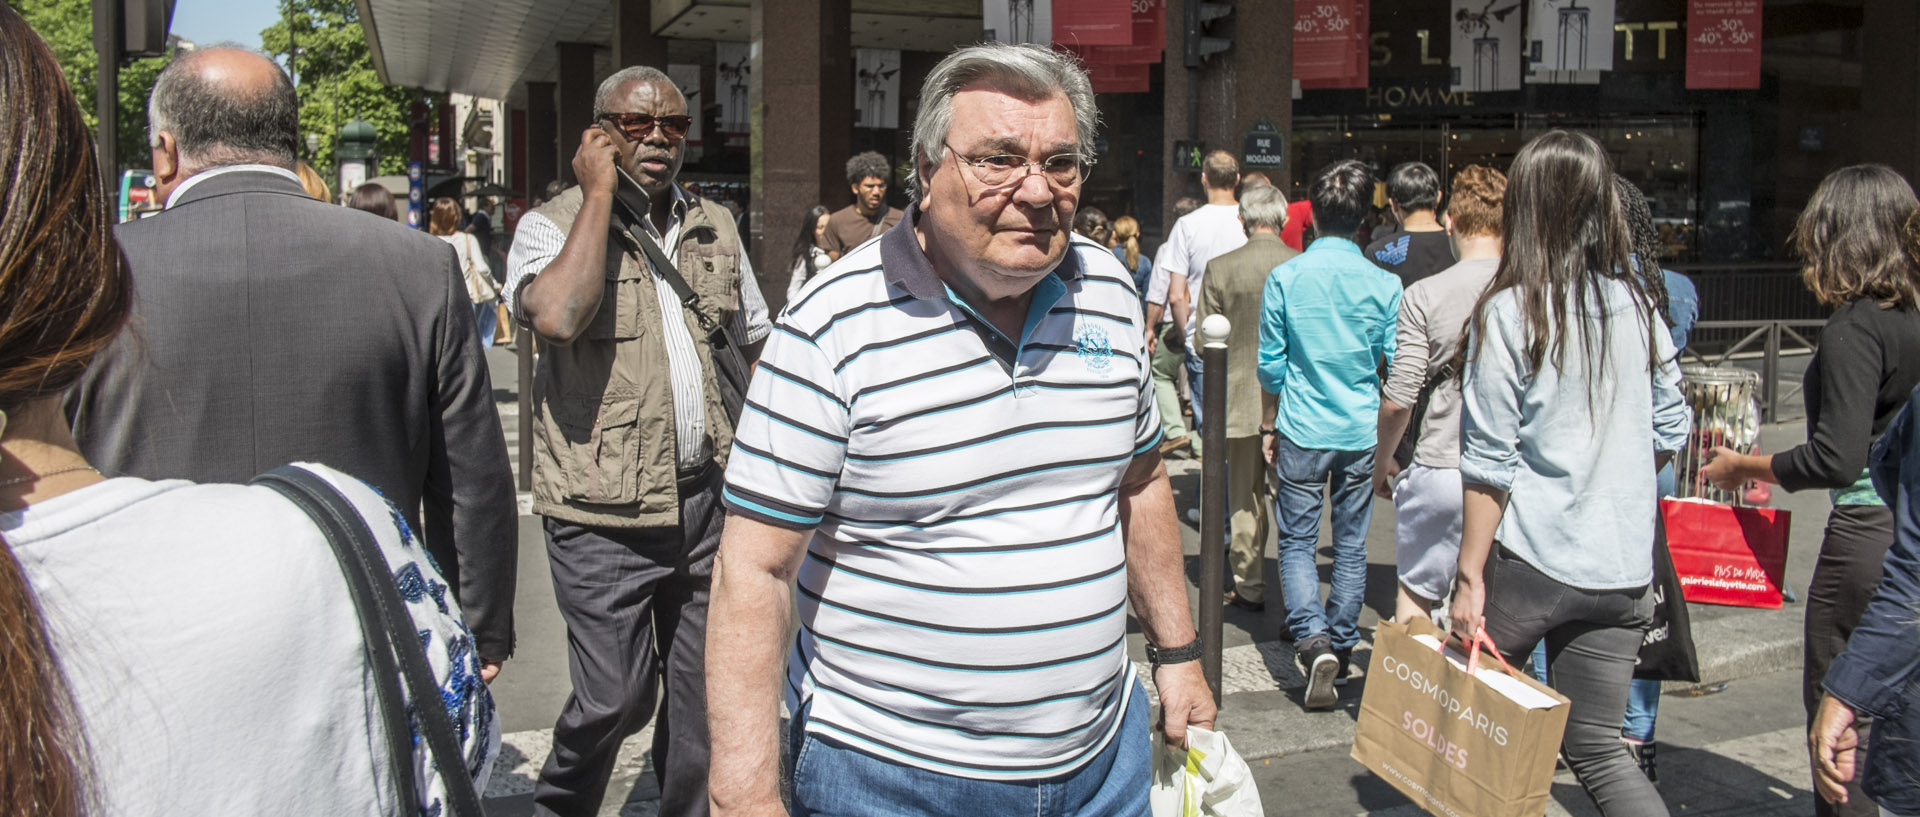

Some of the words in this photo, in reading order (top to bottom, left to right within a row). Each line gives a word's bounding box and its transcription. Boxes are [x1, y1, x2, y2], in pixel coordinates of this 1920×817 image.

[1367, 86, 1475, 108] HOMME
[1256, 138, 1271, 148] RUE
[1245, 154, 1281, 164] MOGADOR
[1681, 575, 1767, 592] galerieslafayette.com
[1382, 655, 1509, 747] COSMOPARIS
[1401, 711, 1469, 769] SOLDES
